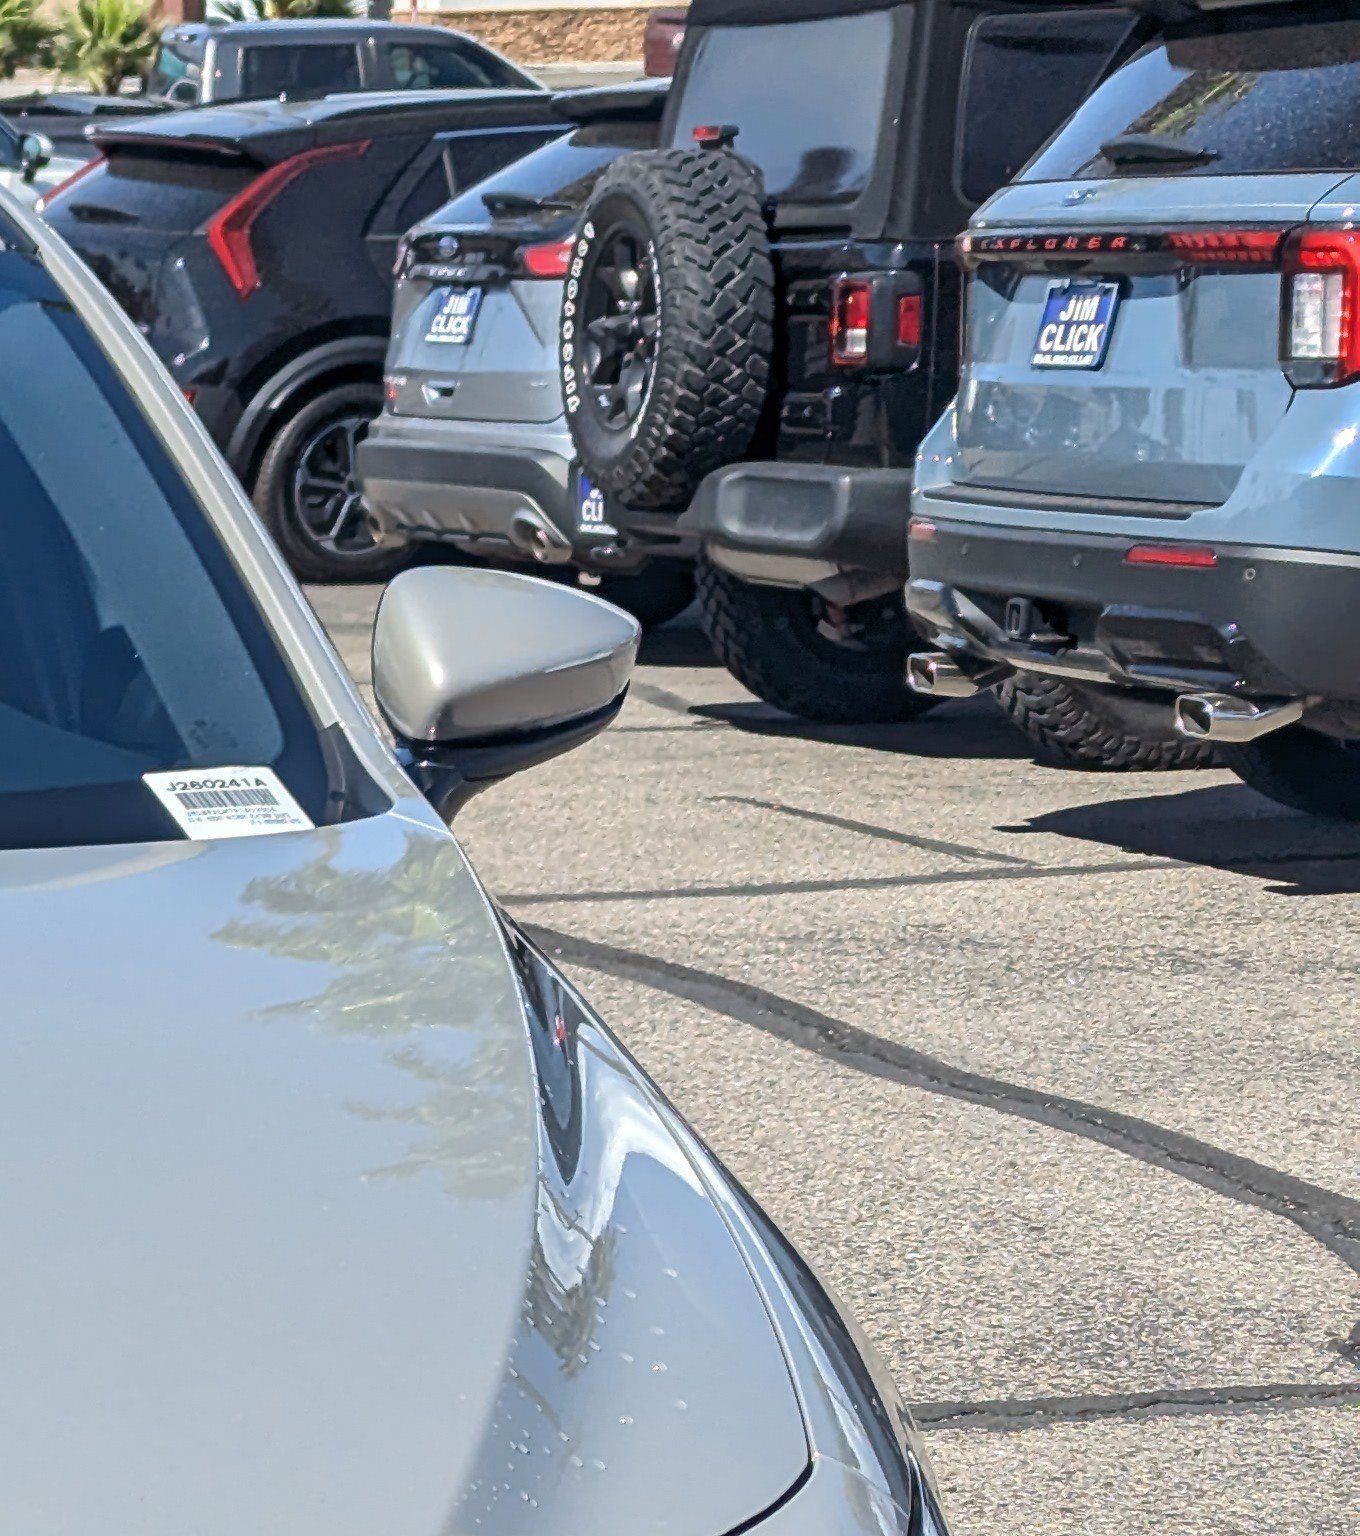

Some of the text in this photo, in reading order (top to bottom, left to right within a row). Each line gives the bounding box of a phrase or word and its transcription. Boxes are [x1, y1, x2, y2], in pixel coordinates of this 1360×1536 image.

[442, 295, 471, 315] JIM
[1058, 293, 1101, 322] JIM
[431, 315, 473, 335] CLICK
[1039, 323, 1105, 352] CLICK
[582, 499, 605, 522] CLI
